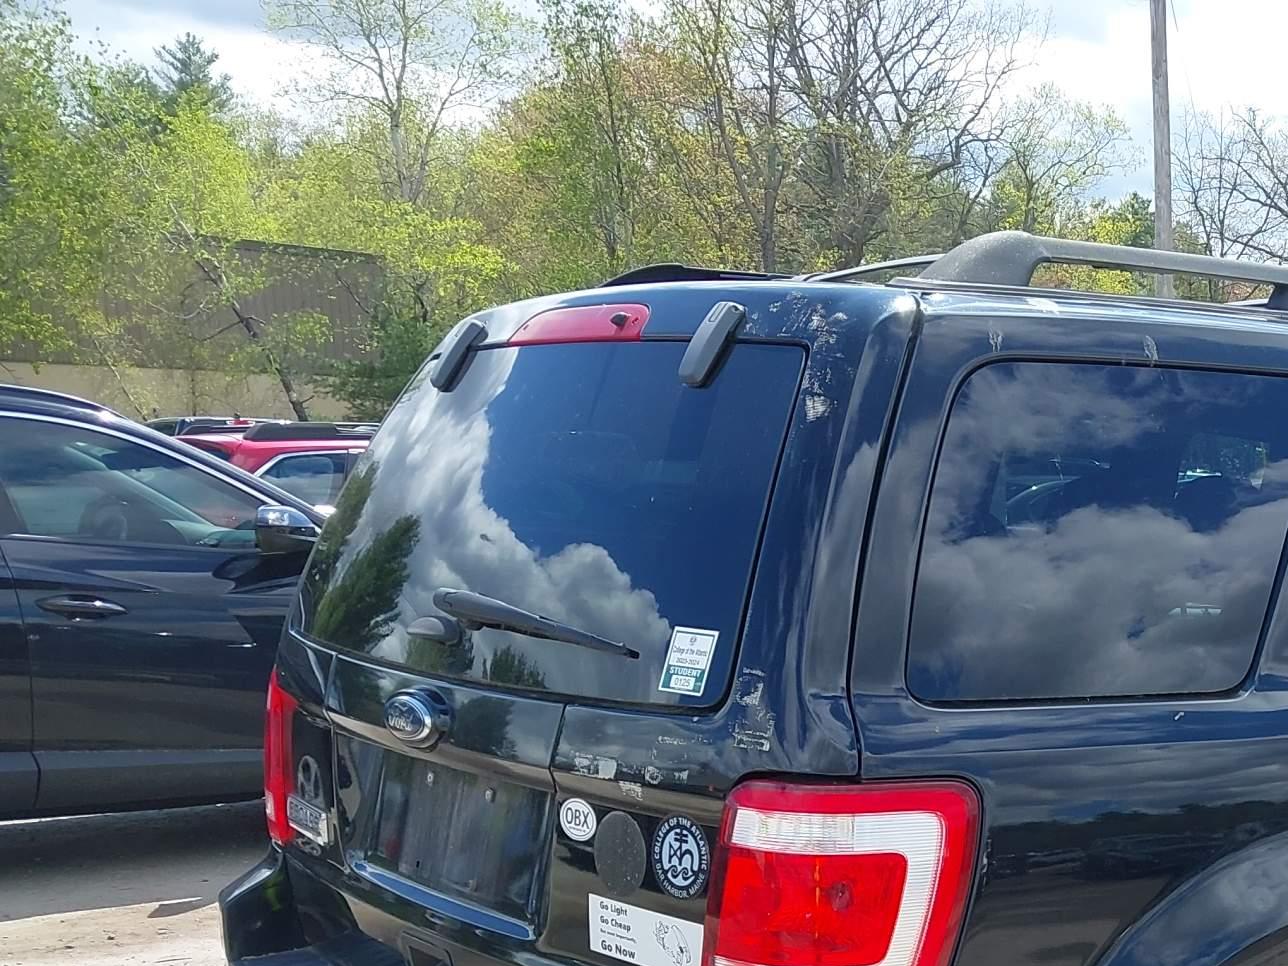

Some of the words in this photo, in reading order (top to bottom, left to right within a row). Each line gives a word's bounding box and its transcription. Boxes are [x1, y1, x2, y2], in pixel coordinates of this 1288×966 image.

[669, 666, 702, 677] STUDENT
[565, 806, 590, 829] OBX
[654, 821, 670, 860] COLLEGE
[669, 817, 678, 827] OF
[678, 817, 691, 828] THE
[690, 824, 708, 871] ATLANTIC
[688, 872, 705, 895] MAINE
[600, 901, 609, 911] Go
[610, 903, 628, 916] Light
[600, 915, 610, 925] Go
[610, 918, 631, 932] Cheap
[601, 939, 613, 952] Go
[615, 943, 636, 959] Now
